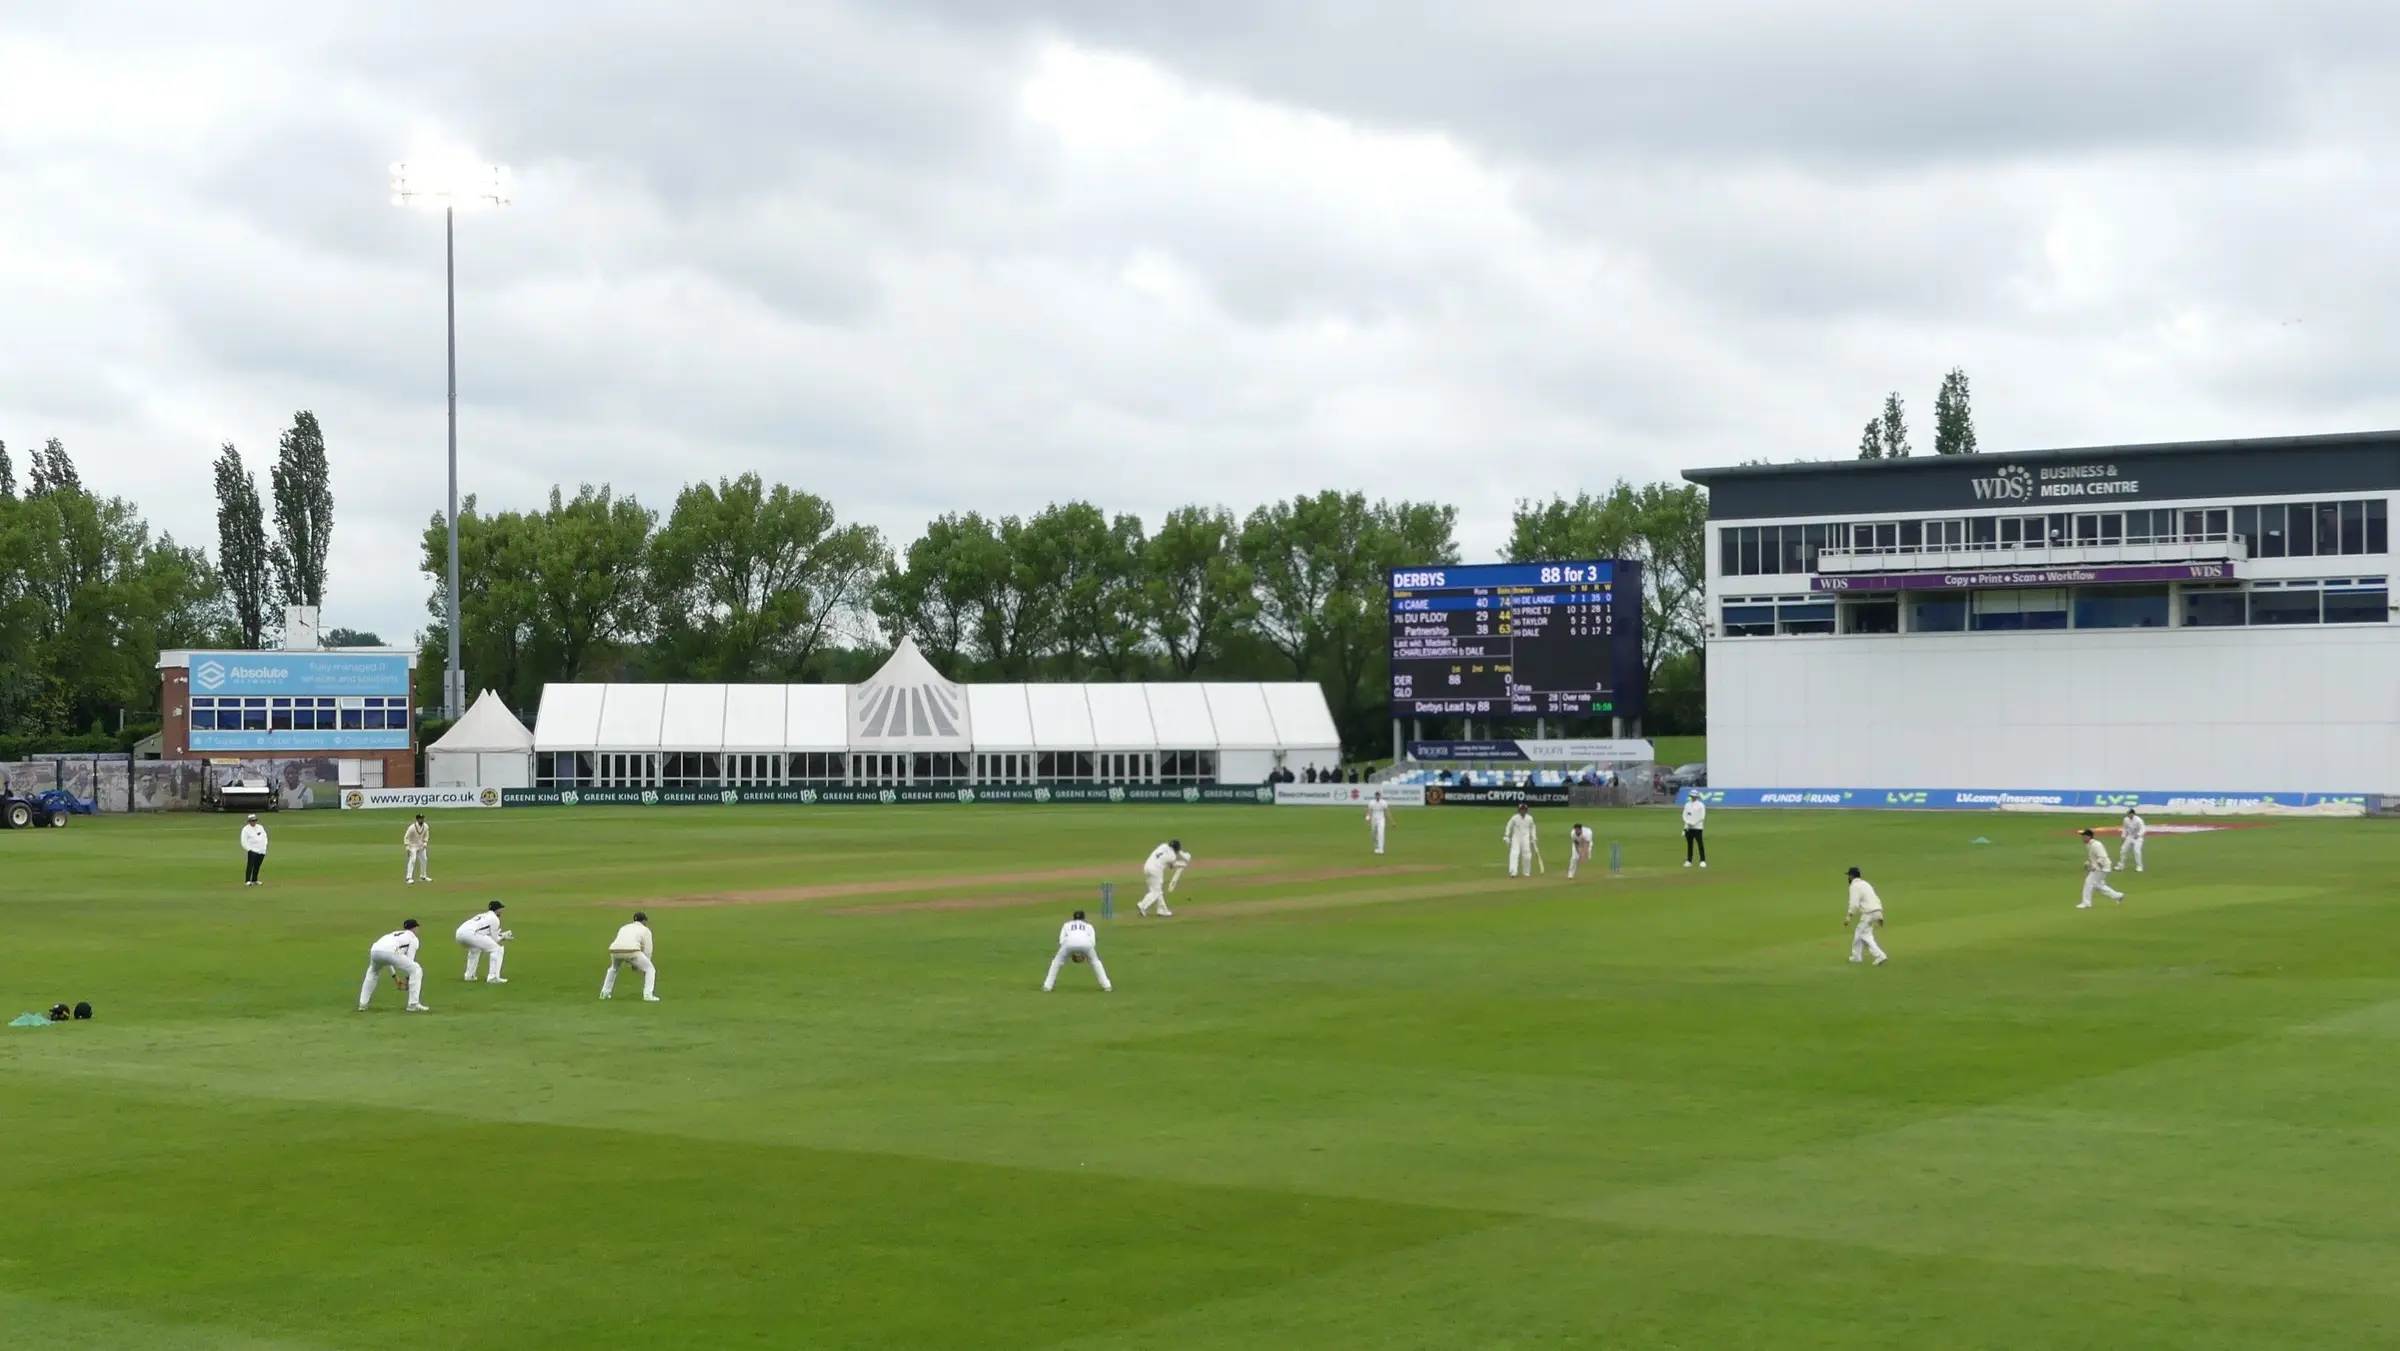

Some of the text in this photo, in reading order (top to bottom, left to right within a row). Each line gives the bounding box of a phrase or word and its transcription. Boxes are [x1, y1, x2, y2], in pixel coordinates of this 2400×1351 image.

[2040, 465, 2118, 480] BUSINESS &
[1972, 477, 2023, 500] WDS
[2041, 481, 2140, 497] MEDIA CENTRE
[1394, 565, 1597, 587] DERBYS 88 for 3
[2190, 565, 2222, 577] WDS
[1820, 578, 1849, 589] WDS
[1945, 570, 2095, 587] Copy Print Scan Workflow
[1604, 583, 1611, 591] W
[1405, 600, 1429, 610] CAME
[1476, 598, 1488, 608] 40
[1499, 597, 1511, 607] 74
[1522, 596, 1531, 604] DE
[1571, 594, 1576, 602] 7
[1591, 594, 1600, 602] 35
[1606, 594, 1611, 602] 0
[1522, 606, 1542, 615] PRICE
[1543, 606, 1551, 615] TJ
[1567, 605, 1576, 613] 10
[1581, 605, 1587, 613] 3
[1591, 604, 1601, 613] 28
[1405, 613, 1418, 623] DU
[1420, 612, 1448, 623] PLOOY
[1476, 611, 1488, 621] 29
[1499, 610, 1511, 621] 44
[1522, 617, 1548, 626] TAYLOR
[1581, 616, 1587, 624] 2
[1606, 615, 1611, 623] 0
[1405, 624, 1511, 637] Partnership 38 63
[1522, 628, 1540, 637] DALE
[1570, 627, 1576, 635] 6
[1581, 627, 1587, 635] 0
[1592, 627, 1600, 635] 17
[1606, 626, 1611, 634] 2
[1452, 638, 1458, 646] 2
[1399, 647, 1458, 657] CHARLESWORTH
[1459, 647, 1464, 655] b
[1465, 646, 1484, 655] DALE
[230, 666, 288, 679] Absolute
[338, 674, 356, 683] and
[357, 674, 398, 683] solutions
[1394, 673, 1511, 686] DER 88 0
[1394, 686, 1511, 698] GLO 1
[1596, 682, 1601, 691] 3
[1562, 693, 1591, 701] Over rate
[1415, 701, 1490, 713] Derbys Lead by 88
[1563, 703, 1579, 711] Time
[538, 793, 559, 801] KING
[561, 791, 579, 803] IPA
[584, 790, 658, 802] GREENE KING IPA
[664, 790, 738, 801] GREENE KING IPA
[777, 792, 798, 800] KING
[800, 789, 817, 801] IPA
[857, 792, 877, 800] KING
[880, 789, 896, 801] IPA
[935, 791, 955, 799] KING
[958, 788, 975, 800] IPA
[1013, 790, 1033, 798] KING
[1034, 788, 1051, 799] IPA
[1055, 787, 1125, 798] GREENE KING IPA
[1130, 787, 1199, 798] GREENE KING IPA
[1204, 790, 1233, 798] GREENE
[1235, 789, 1255, 798] KING
[1256, 787, 1272, 798] IPA
[1445, 793, 1475, 801] RECOVER
[1487, 790, 1525, 801] CRYPTO
[1761, 792, 1840, 803] #FUNDS4RUNS
[370, 792, 475, 806] www.raygar.co.uk
